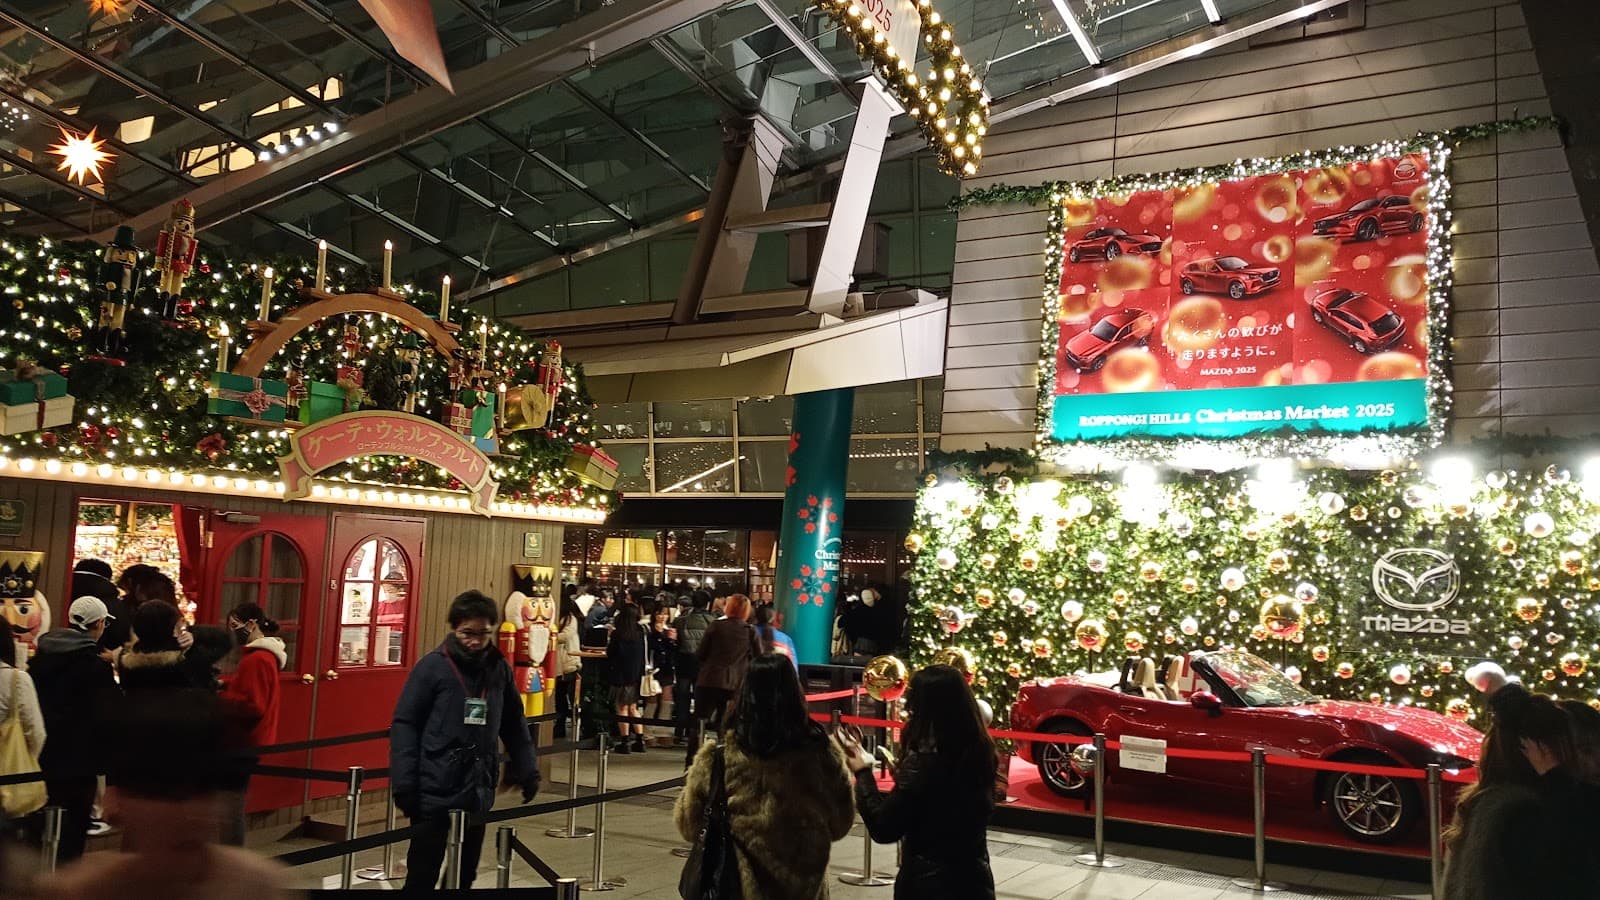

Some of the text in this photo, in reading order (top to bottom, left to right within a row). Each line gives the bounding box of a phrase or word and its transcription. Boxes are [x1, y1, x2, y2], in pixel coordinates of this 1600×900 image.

[861, 0, 892, 31] 025
[1175, 323, 1283, 344] くさんの歓びが
[1182, 345, 1276, 361] 走りますように。
[1199, 366, 1257, 376] MAZDA 2025
[1079, 403, 1395, 427] ROPPONGI HILLS Christmas Market 2025
[308, 420, 479, 473] ケーテ・ウォルファルト
